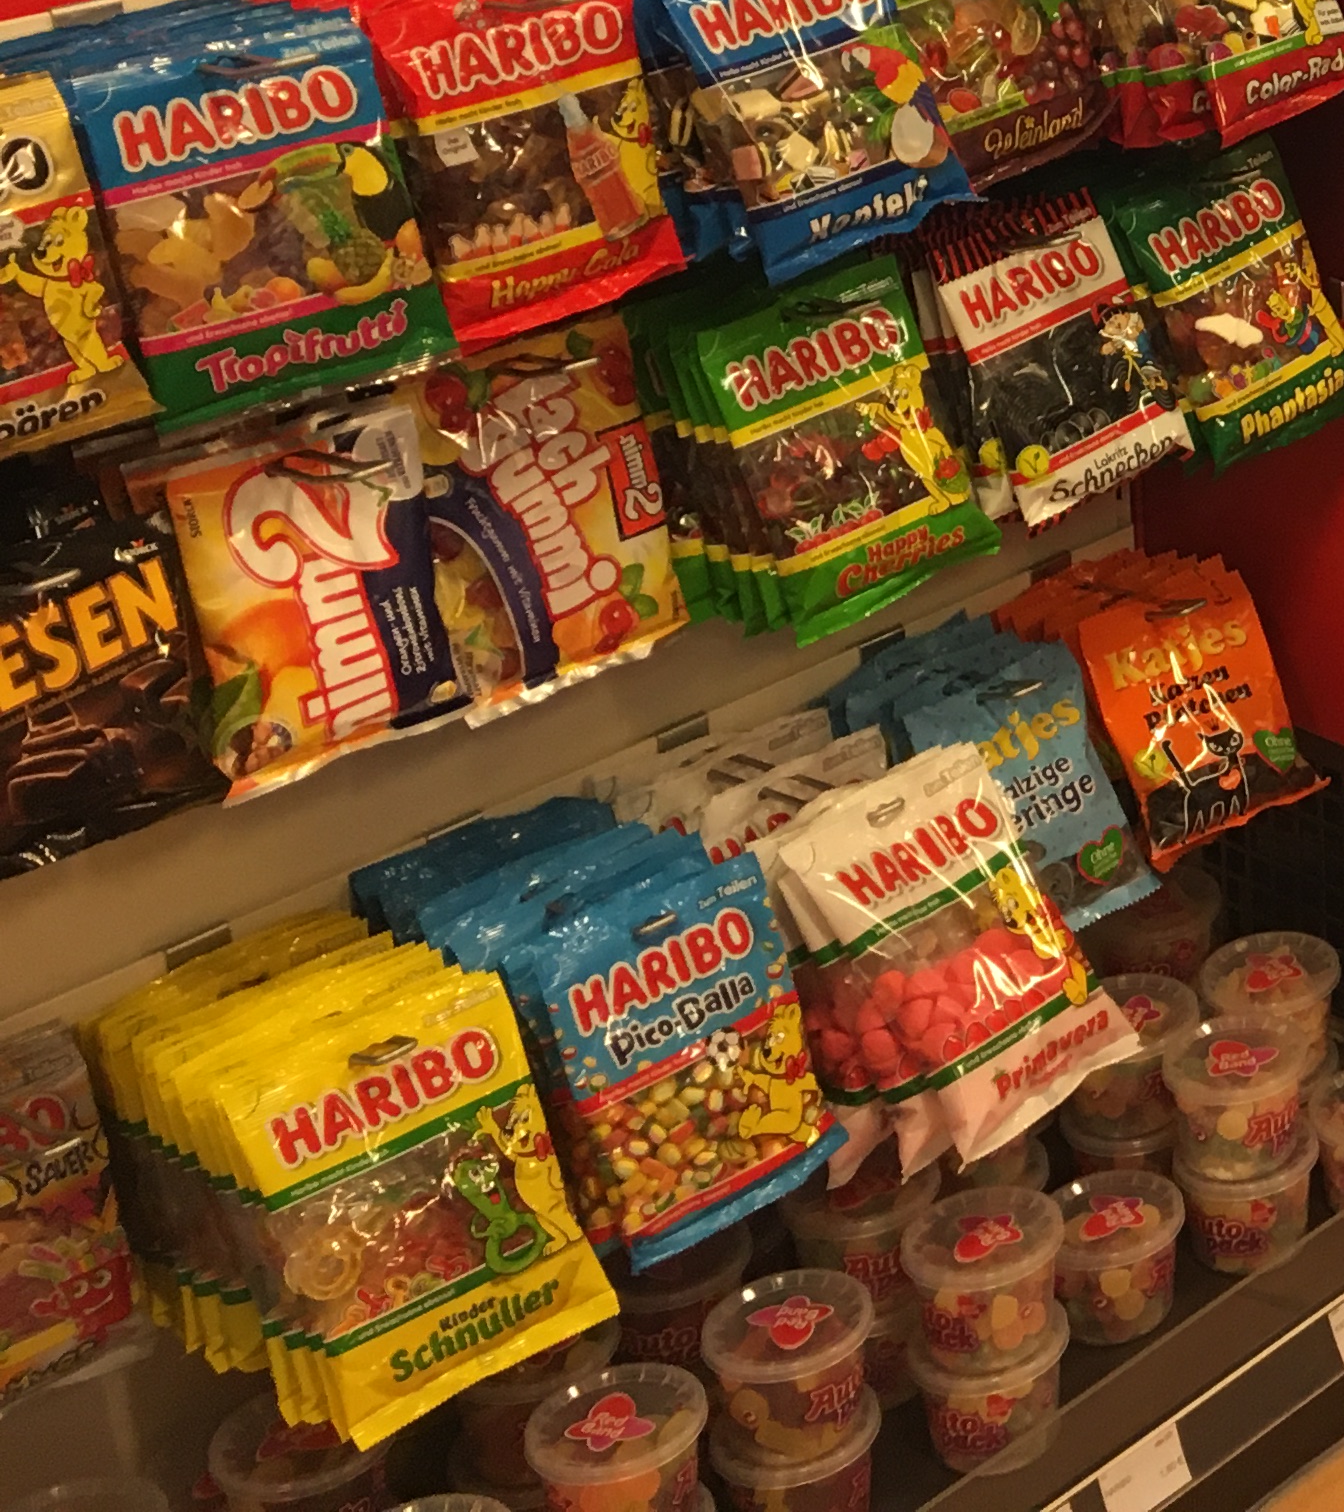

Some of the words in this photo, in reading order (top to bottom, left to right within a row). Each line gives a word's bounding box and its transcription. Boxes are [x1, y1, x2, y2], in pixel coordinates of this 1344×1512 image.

[410, 1, 623, 100] HARIBO
[114, 65, 357, 172] HARIBO
[984, 97, 1083, 159] Weinland
[809, 175, 929, 241] Konfekt
[1148, 178, 1285, 275] HARIBO
[491, 263, 576, 308] Happy
[583, 239, 639, 276] Cola
[959, 240, 1101, 331] HARIBO
[196, 299, 408, 393] Tropifrutti
[725, 306, 901, 411] HARIBO
[1240, 367, 1344, 444] Phantasia
[1050, 436, 1173, 502] Schnecken
[1094, 446, 1129, 471] Lakritz
[836, 525, 965, 598] Cherries
[867, 524, 930, 563] Happy
[1105, 619, 1247, 689] Katjes
[976, 698, 1080, 771] atjes
[1004, 756, 1072, 800] alzige
[1010, 772, 1096, 836] eringe
[717, 874, 757, 898] Teilen
[836, 798, 998, 906] HARIBO
[569, 907, 754, 1037] HARIBO
[607, 973, 754, 1065] Pico-Balla
[996, 1009, 1109, 1100] Primavera
[1218, 1056, 1257, 1070] Band
[1221, 1050, 1250, 1062] Red
[265, 1028, 501, 1170] HARIBO
[390, 1277, 559, 1381] Schnuller
[439, 1296, 497, 1333] Kinder
